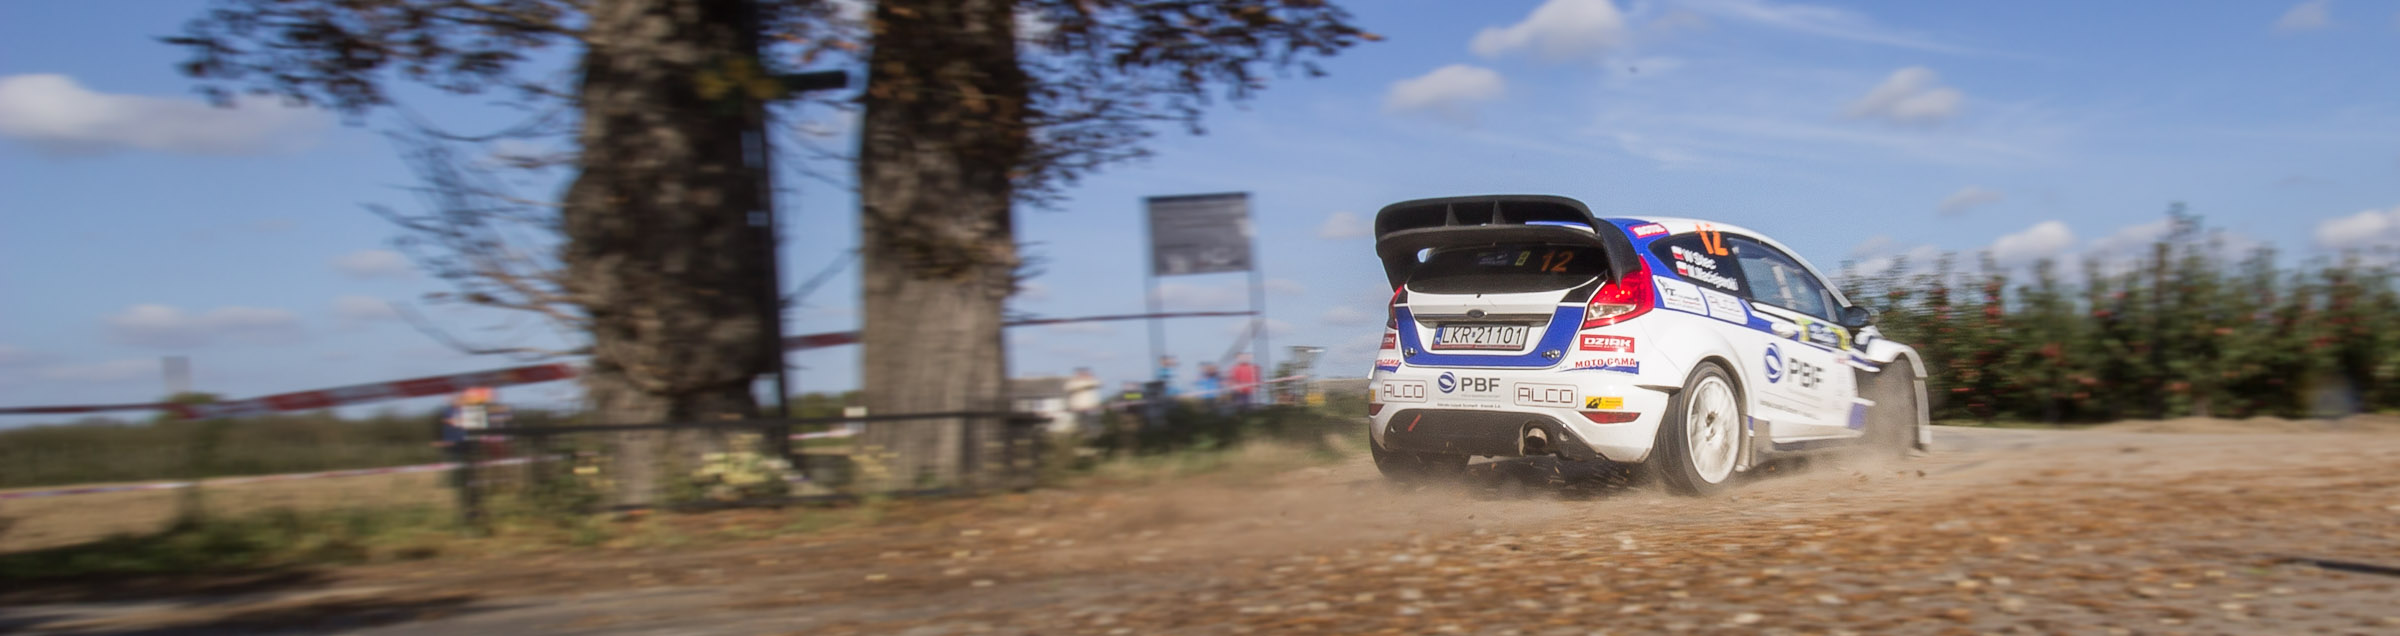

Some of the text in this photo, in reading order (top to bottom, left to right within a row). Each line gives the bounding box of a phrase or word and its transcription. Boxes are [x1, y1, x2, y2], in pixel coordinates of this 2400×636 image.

[1695, 222, 1728, 256] 12
[1541, 250, 1574, 272] 12
[1442, 326, 1523, 345] LKR 21101
[1575, 359, 1604, 368] MOTO
[1787, 357, 1826, 389] PBF
[1384, 384, 1425, 398] ALCO
[1461, 377, 1501, 392] PBF
[1517, 387, 1573, 403] ALCO
